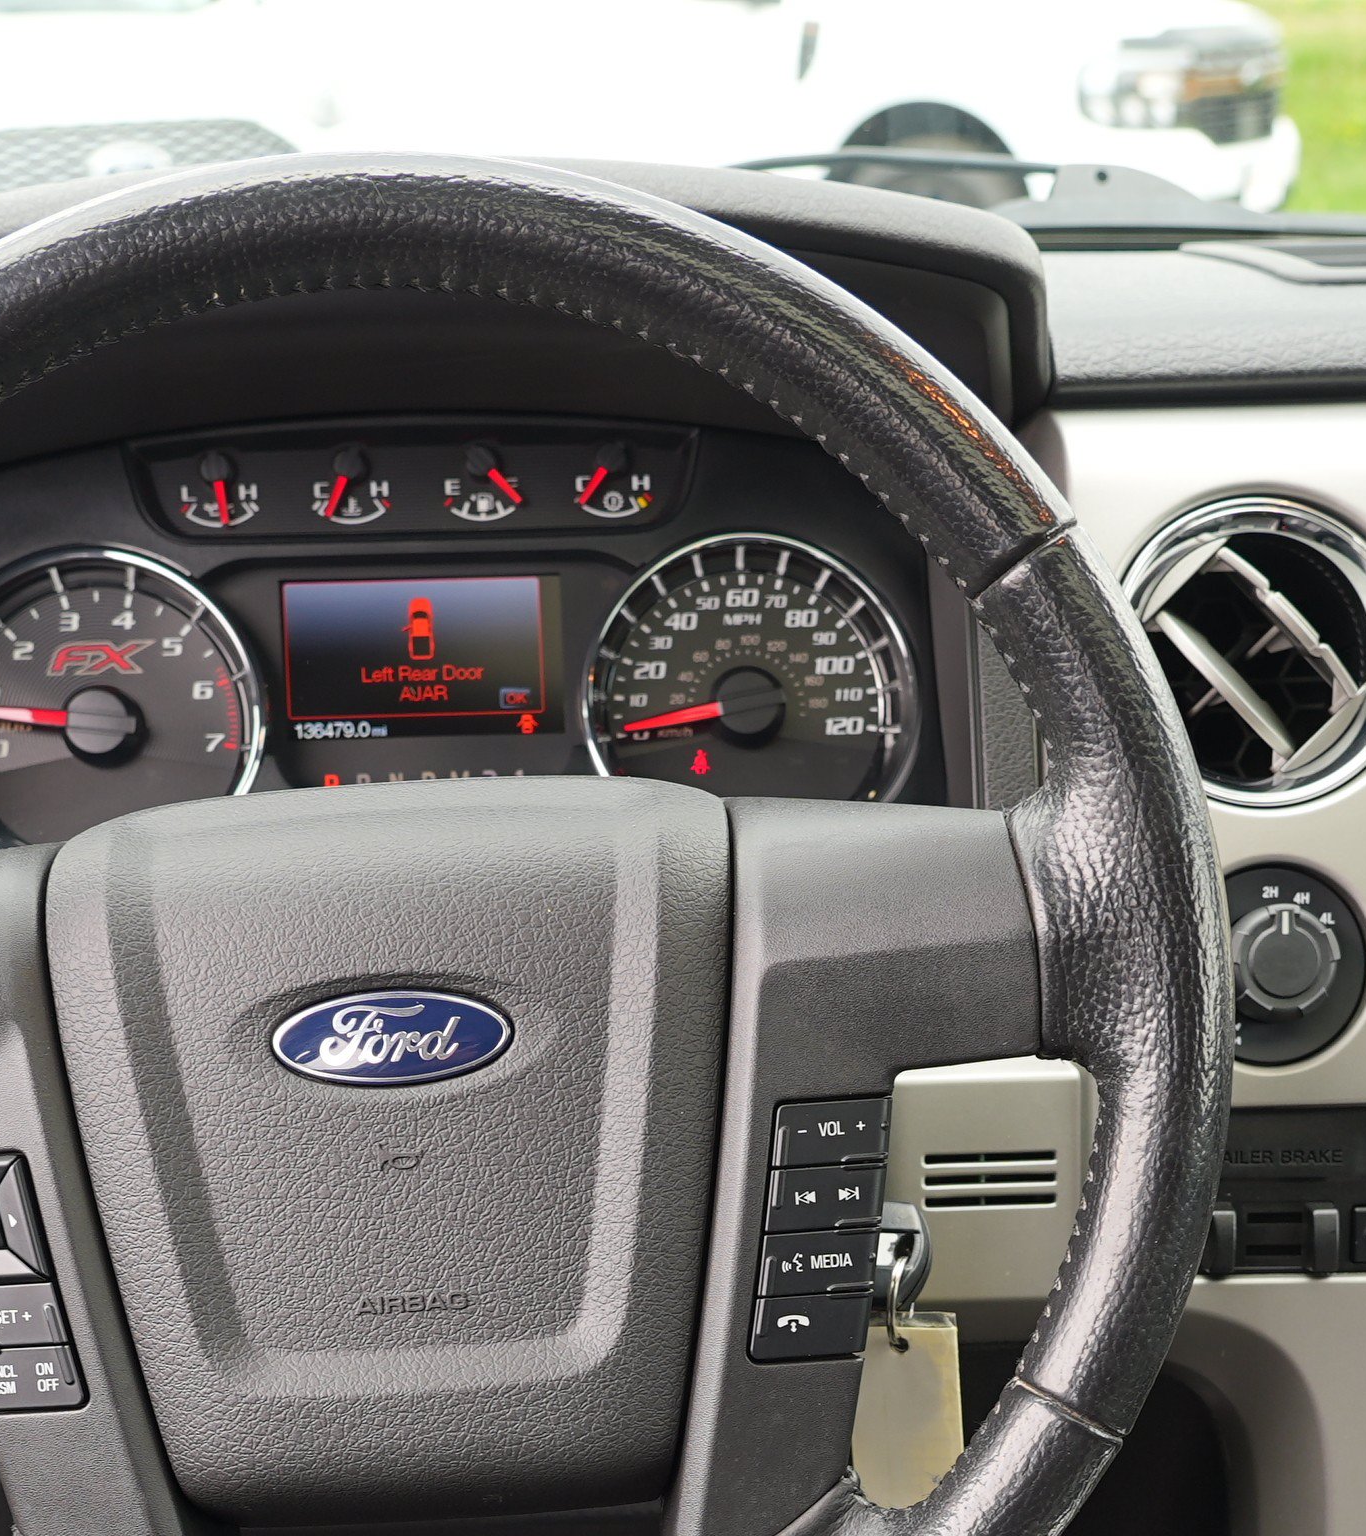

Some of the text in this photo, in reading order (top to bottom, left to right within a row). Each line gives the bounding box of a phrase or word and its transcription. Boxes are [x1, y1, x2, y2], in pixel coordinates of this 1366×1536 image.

[237, 483, 259, 501] H
[369, 480, 390, 498] H
[443, 478, 462, 497] E
[630, 474, 652, 492] H
[180, 484, 198, 503] L
[695, 596, 721, 611] 50
[726, 588, 760, 608] 60
[764, 594, 789, 609] 70
[59, 612, 81, 633] 3
[111, 611, 136, 631] 4
[664, 611, 699, 631] 40
[722, 613, 762, 626] MPH
[785, 609, 819, 629] 80
[161, 637, 184, 657] 5
[648, 635, 674, 650] 30
[812, 632, 838, 646] 90
[12, 641, 35, 661] 2
[46, 639, 158, 676] FX
[361, 664, 484, 683] Left Rear Door
[633, 661, 667, 680] 20
[814, 656, 855, 675] 100
[191, 680, 214, 700] 6
[399, 684, 449, 701] AJAR
[506, 690, 527, 704] OK
[835, 688, 863, 702] 110
[629, 694, 648, 707] 10
[294, 721, 371, 740] 136479.0
[825, 717, 865, 735] 120
[204, 733, 226, 753] 7
[1262, 886, 1279, 899] 2H
[1293, 892, 1310, 905] 4H
[1319, 912, 1335, 925] 4L
[320, 1004, 461, 1066] Ford
[818, 1121, 845, 1137] VOL
[1222, 1148, 1344, 1165] AILER BRAKE
[810, 1252, 853, 1270] MEDIA
[357, 1290, 471, 1316] AIRBAG
[35, 1363, 54, 1375] ON
[37, 1379, 60, 1392] OFF
